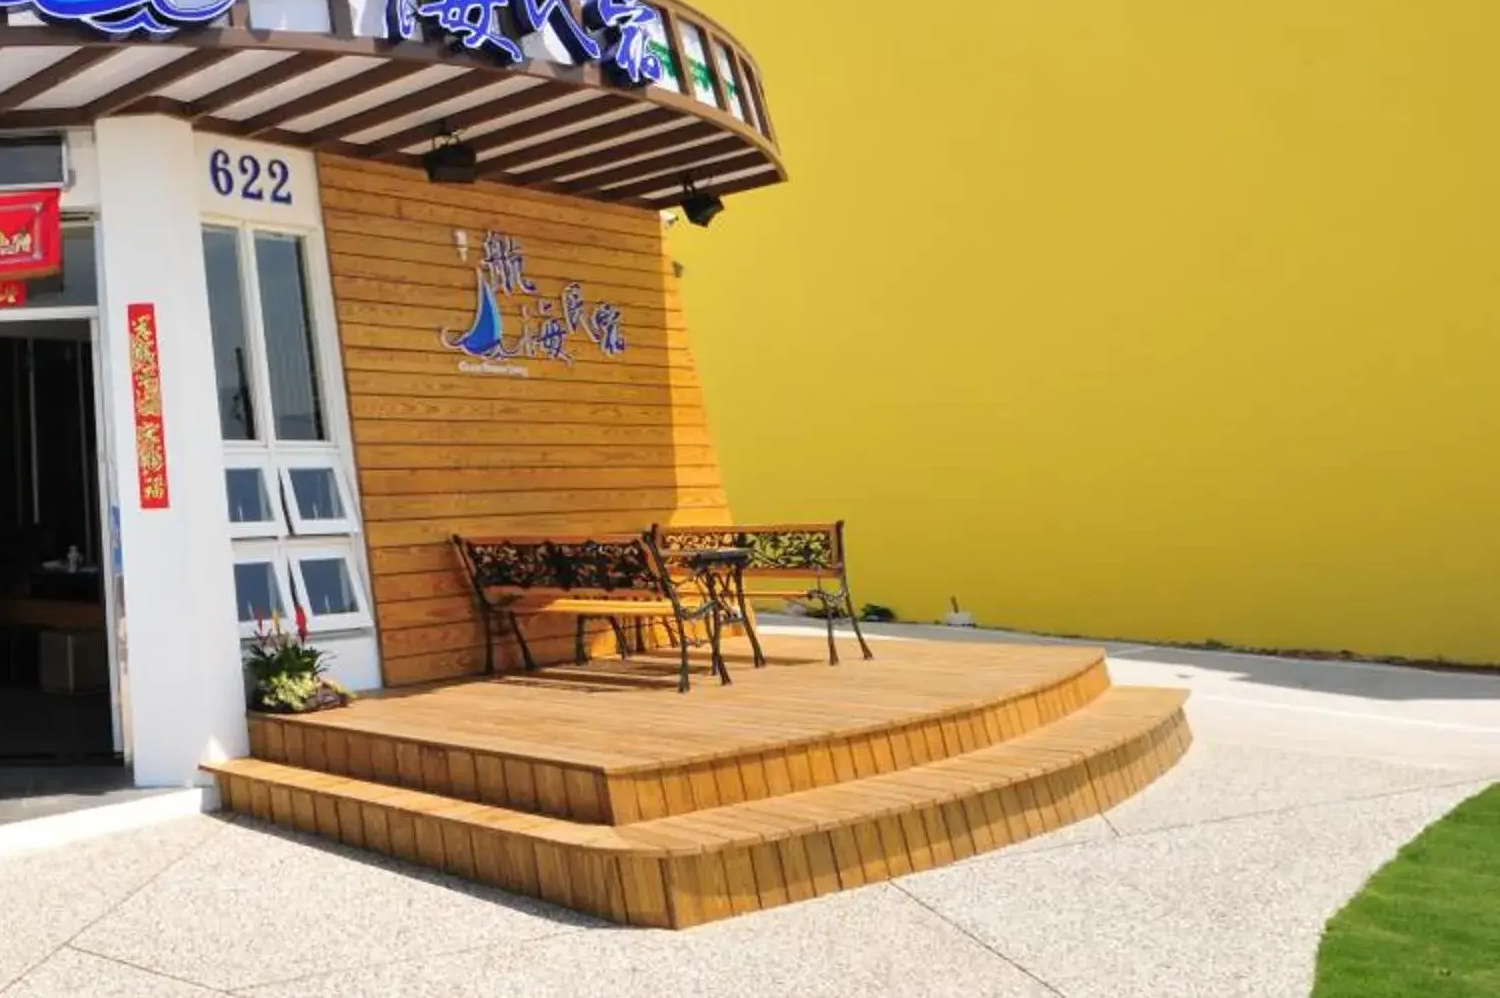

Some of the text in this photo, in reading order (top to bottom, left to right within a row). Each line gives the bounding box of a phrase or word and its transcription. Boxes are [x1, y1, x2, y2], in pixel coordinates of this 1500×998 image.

[210, 148, 293, 205] 622
[481, 230, 626, 366] 航海民宿
